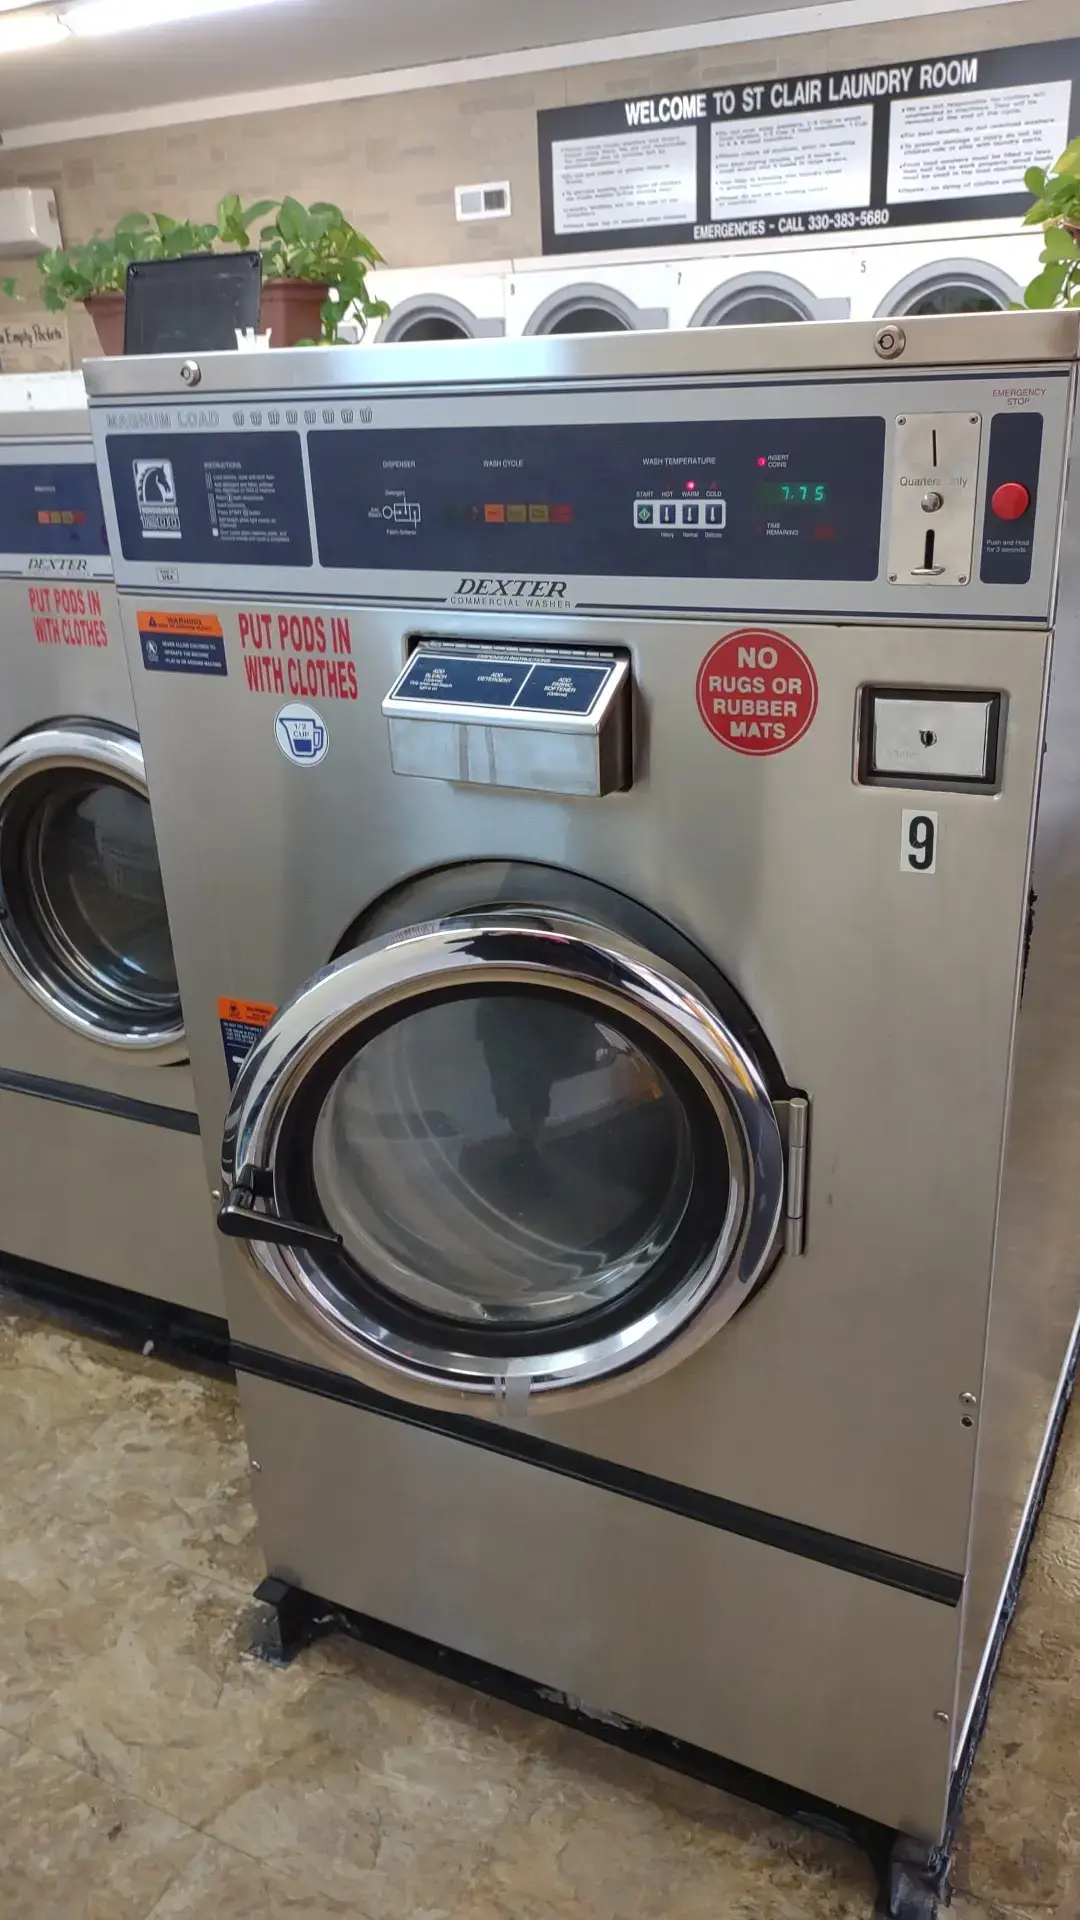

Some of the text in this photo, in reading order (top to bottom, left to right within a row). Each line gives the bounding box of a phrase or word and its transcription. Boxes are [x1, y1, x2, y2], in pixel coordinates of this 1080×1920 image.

[625, 58, 978, 126] WELCOME TO ST CLAIR LAUNDRY ROOM
[693, 219, 766, 241] EMERGENCIES
[778, 216, 805, 233] CALL
[808, 208, 890, 230] 330-383-5680
[860, 260, 866, 274] 5
[992, 388, 1047, 397] EMERGENCY
[1007, 398, 1030, 406] STOP
[177, 410, 220, 428] LOAD
[382, 460, 416, 468] DISPENSER
[483, 459, 524, 468] WASH CYCLE
[642, 457, 716, 466] WASH TEMPERATURE
[947, 476, 968, 488] nly
[782, 486, 825, 501] 7.75
[28, 558, 87, 570] DEXTER
[454, 578, 568, 598] DEXTER
[28, 587, 102, 616] PUT PODS IN
[450, 596, 571, 608] COMMERCIAL WASHER
[33, 616, 108, 648] WITH CLOTHES
[238, 612, 352, 654] PUT PODS IN
[737, 646, 778, 670] NO
[244, 655, 358, 700] WITH CLOTHES
[708, 676, 802, 695] RUGS OR
[713, 698, 798, 718] RUBBER
[730, 721, 786, 739] MATS
[908, 815, 935, 870] 9
